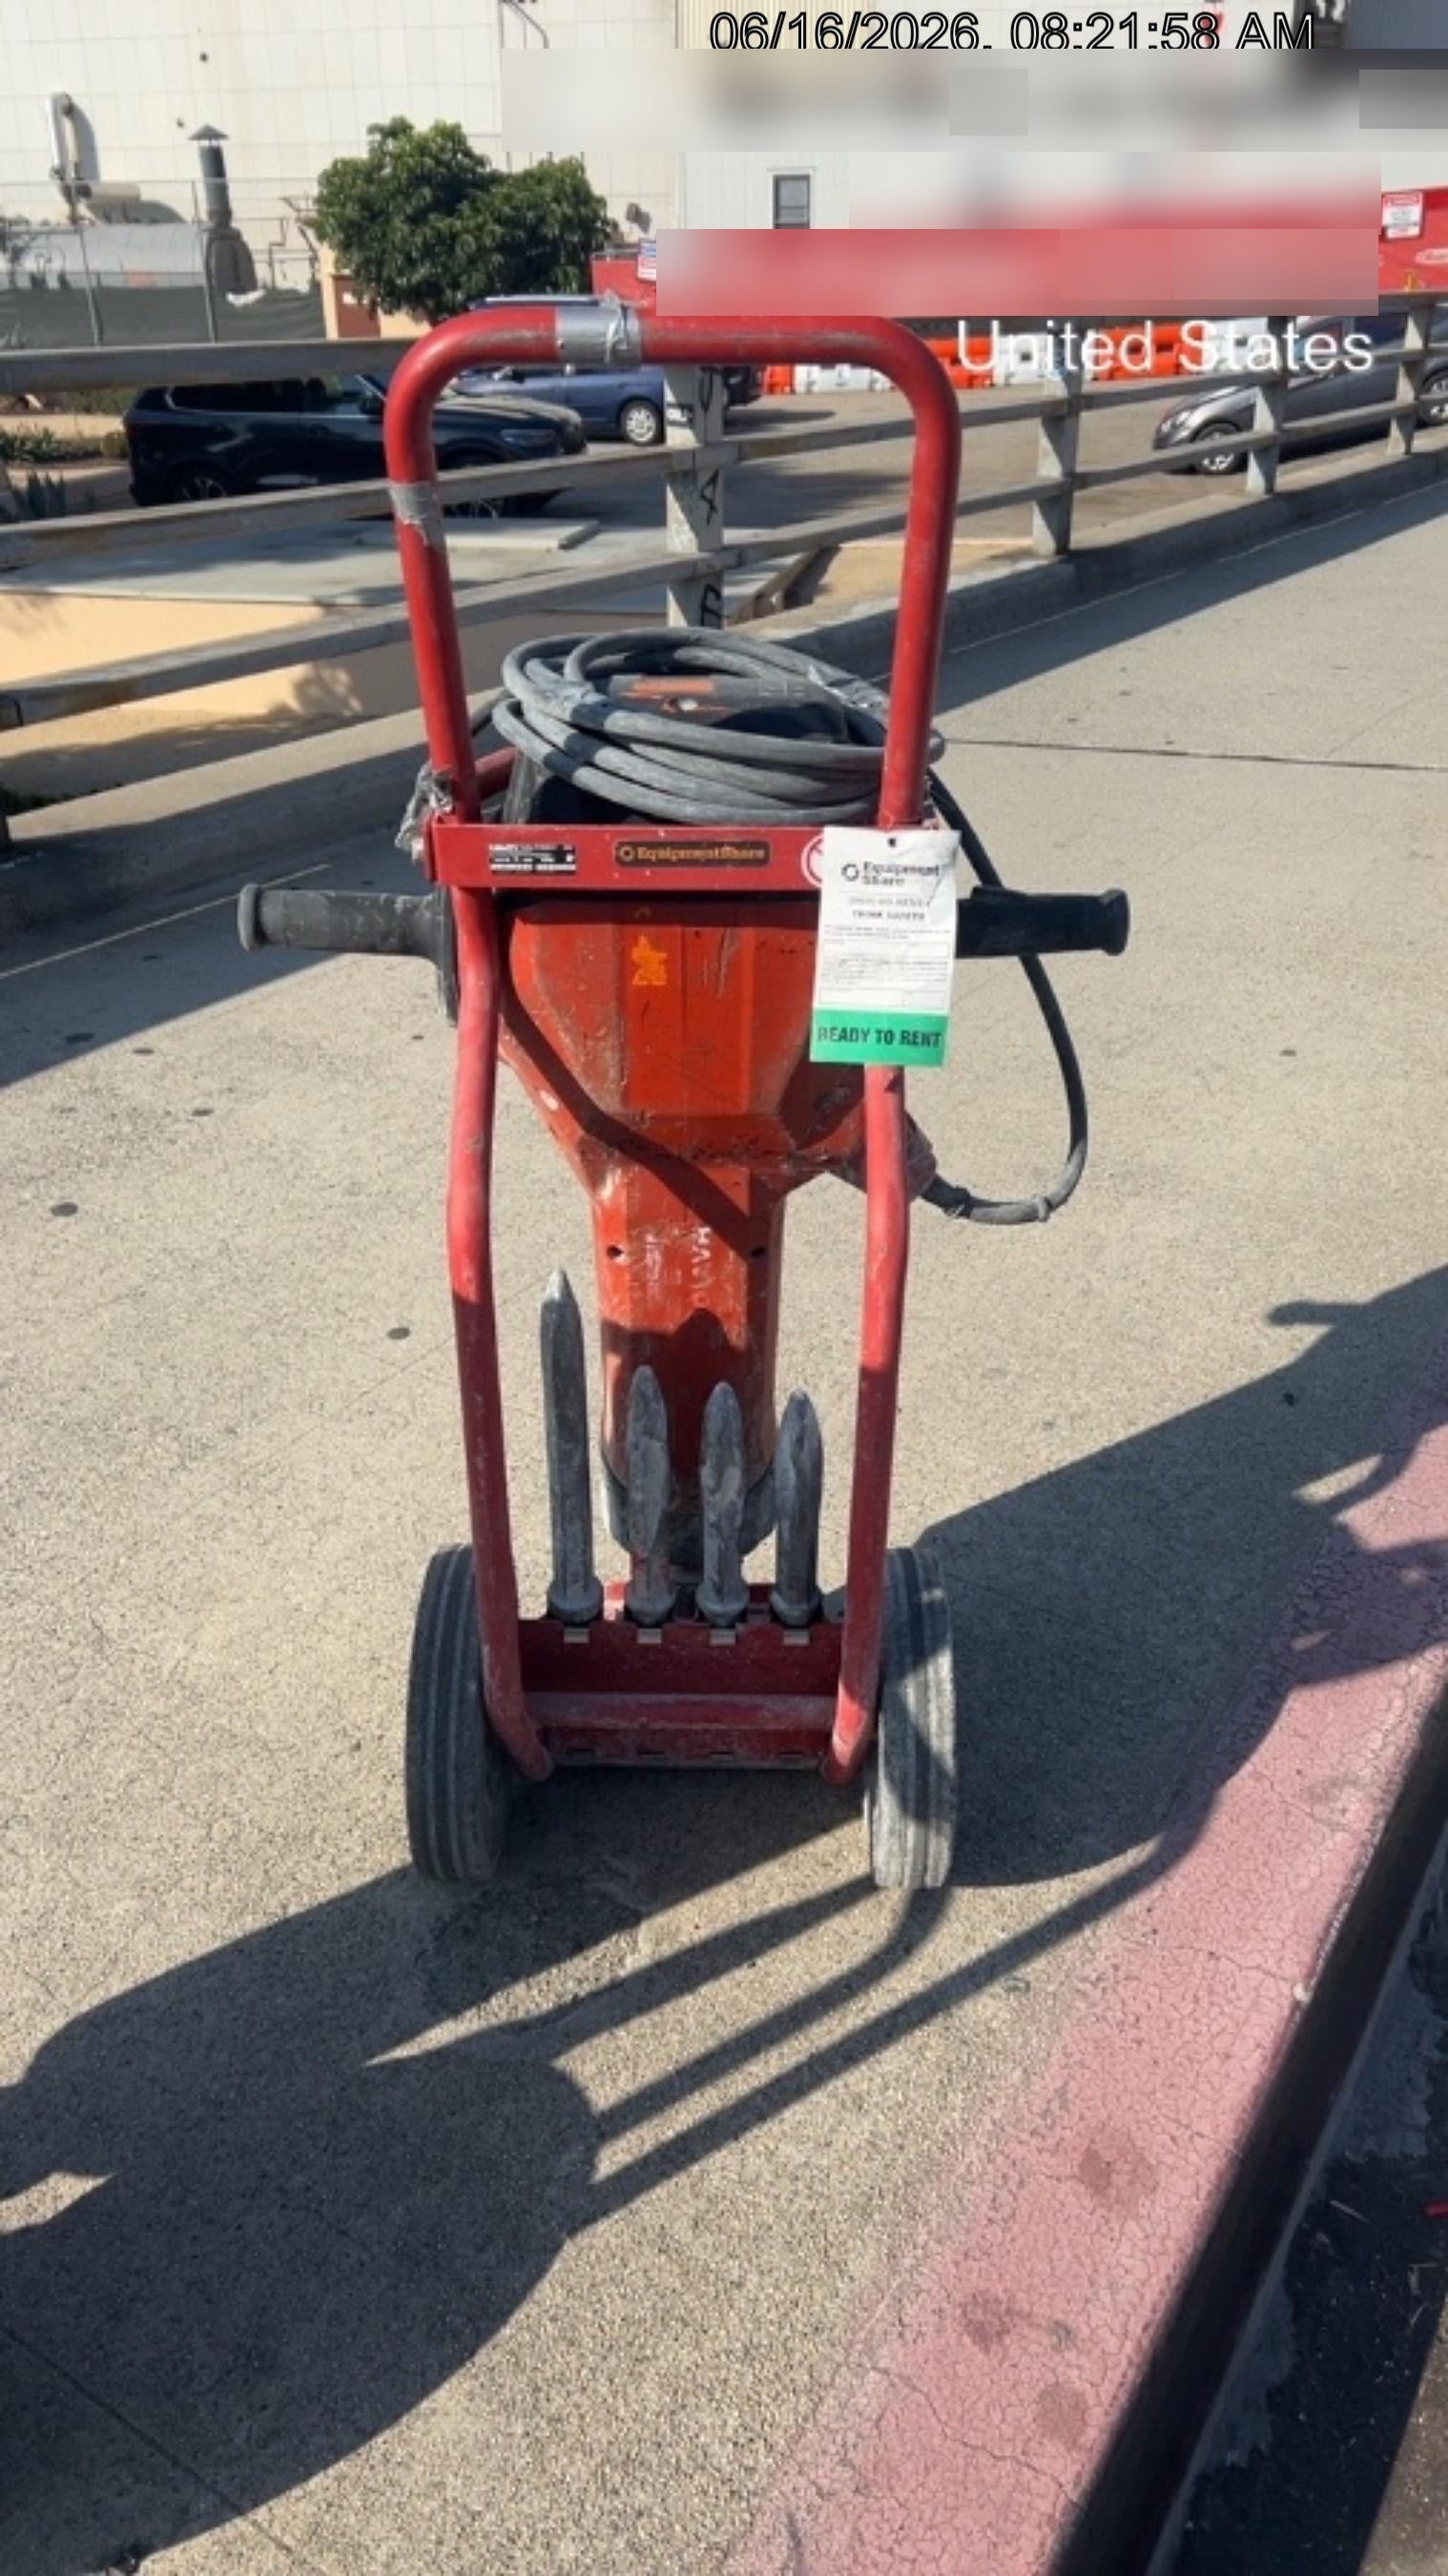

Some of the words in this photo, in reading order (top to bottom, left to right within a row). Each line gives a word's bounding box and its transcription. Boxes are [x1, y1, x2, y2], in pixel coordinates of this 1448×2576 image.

[636, 845, 765, 862] EquipmentShare
[817, 1027, 871, 1043] READY
[875, 1028, 895, 1046] TO
[900, 1029, 942, 1048] RENT
